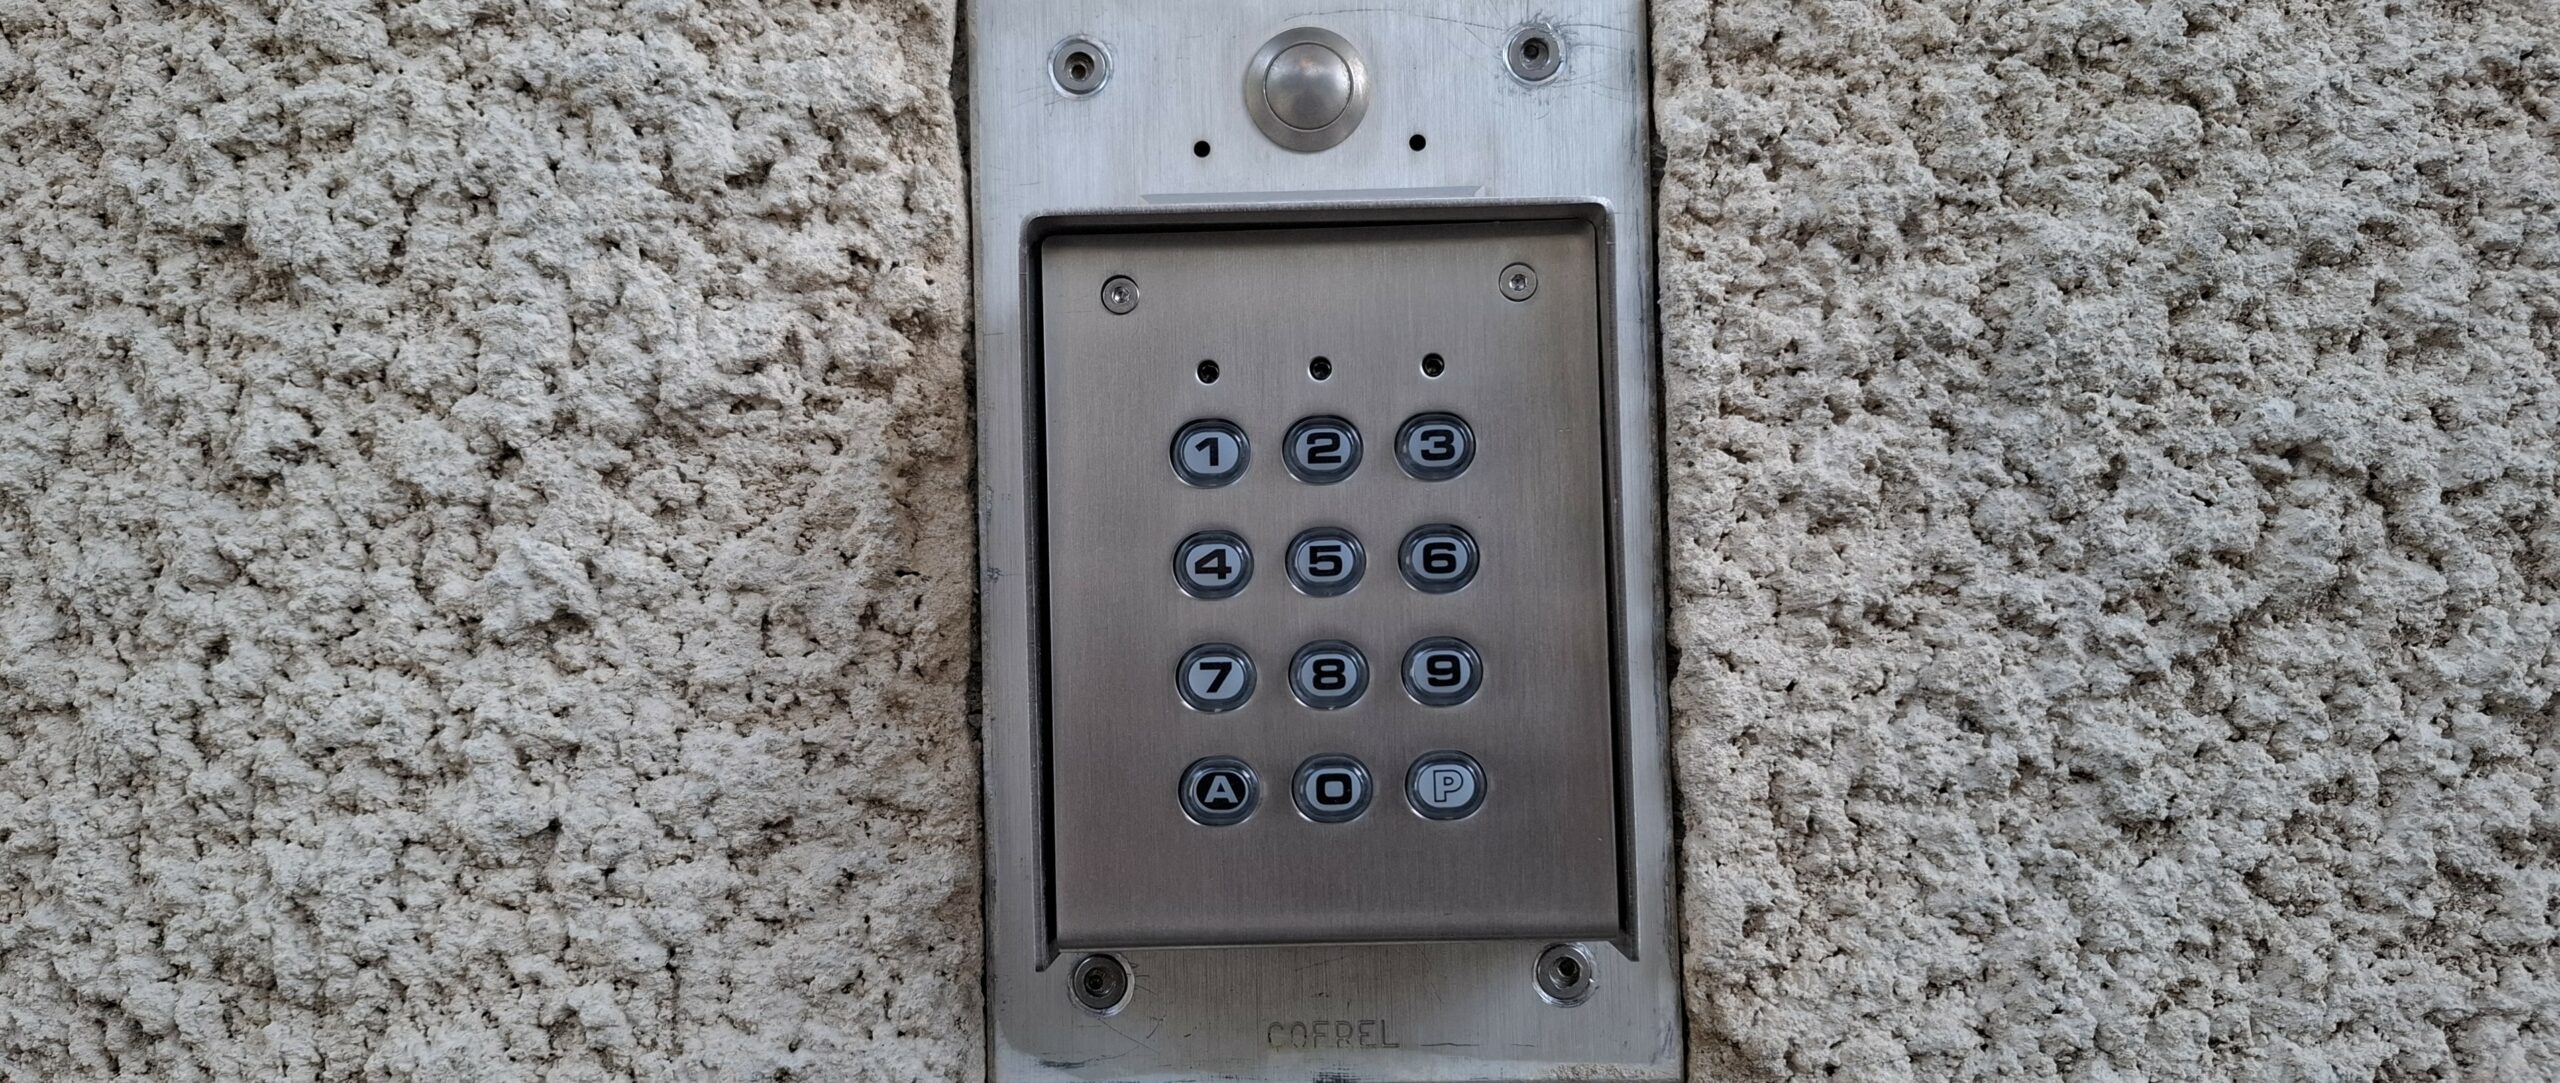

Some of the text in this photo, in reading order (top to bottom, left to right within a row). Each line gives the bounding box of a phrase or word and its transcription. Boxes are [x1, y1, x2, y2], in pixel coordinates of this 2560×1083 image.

[1195, 430, 1455, 466] 1 2 3
[1194, 542, 1456, 579] 4 5 6
[1199, 655, 1461, 693] 7 8 9
[1204, 769, 1463, 804] A 0 P
[1267, 1019, 1400, 1049] COFREL
